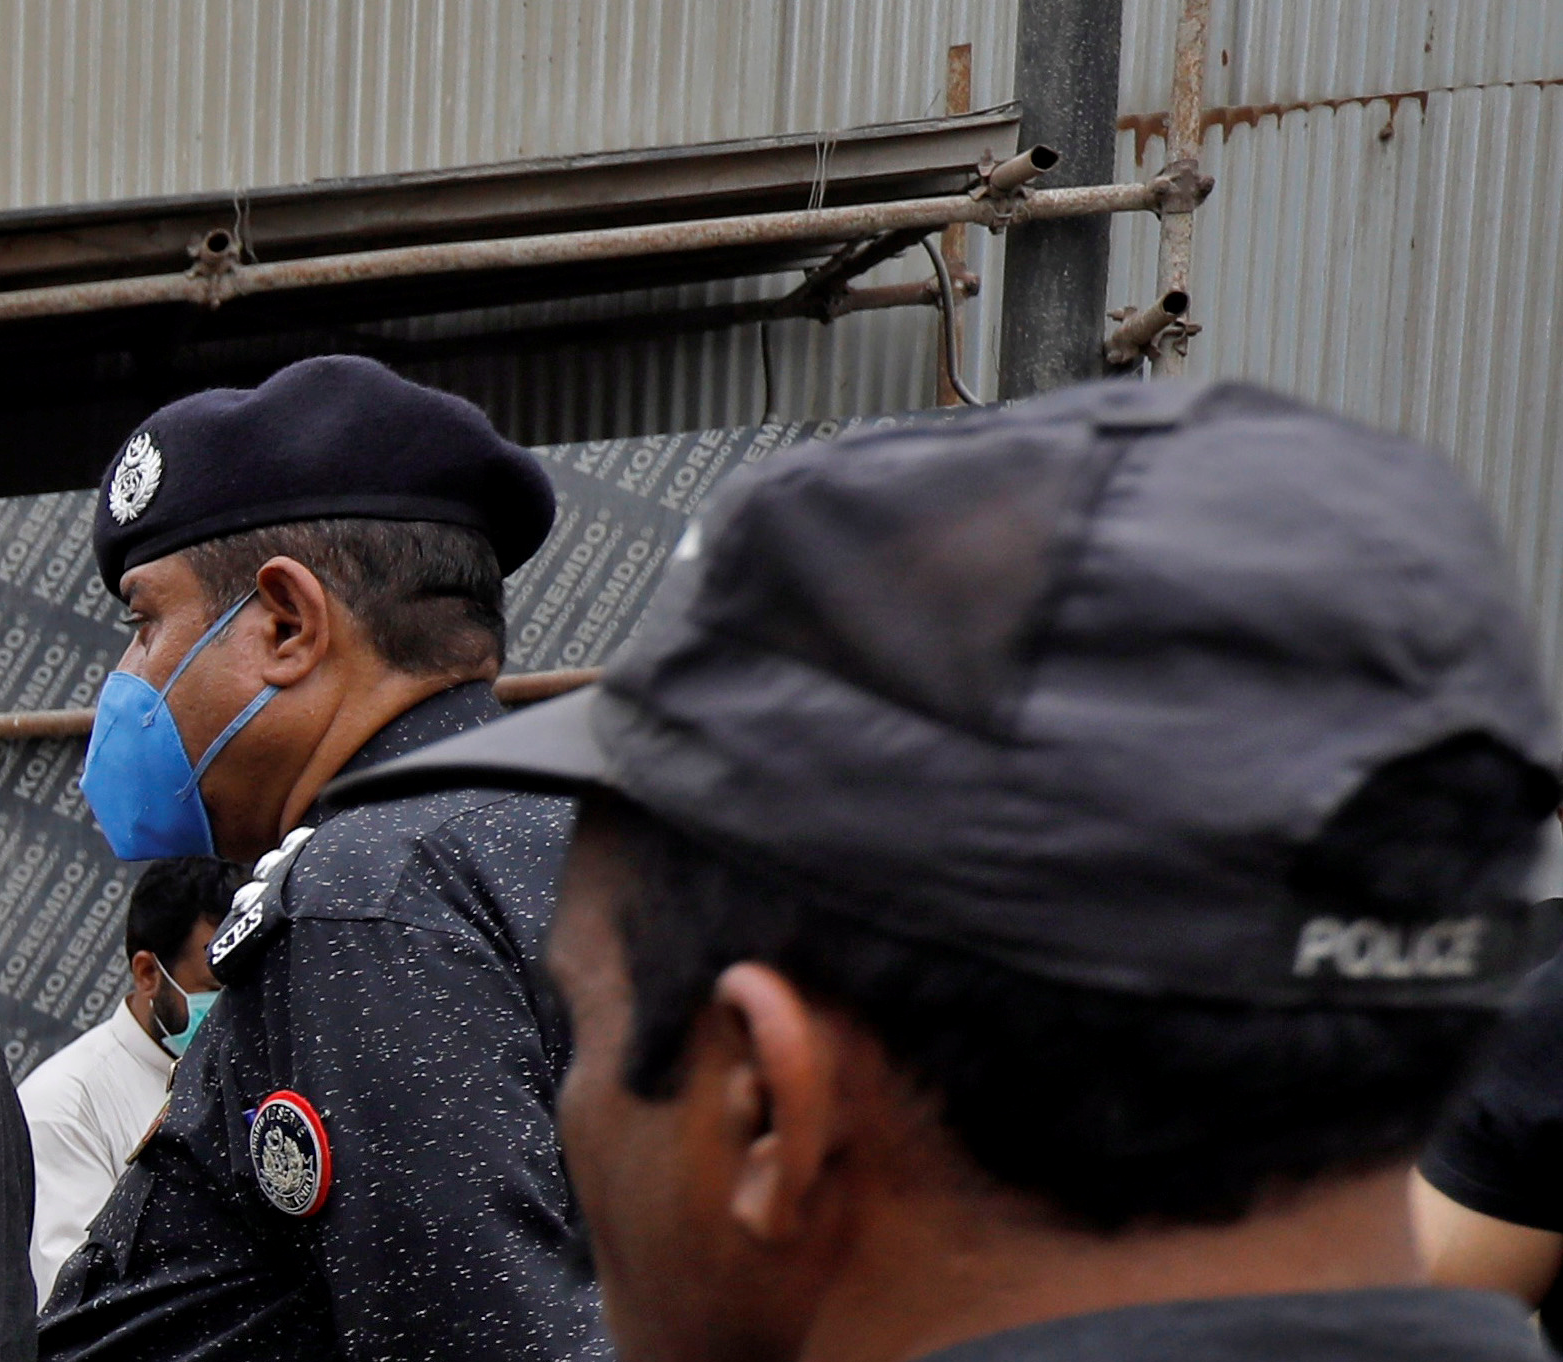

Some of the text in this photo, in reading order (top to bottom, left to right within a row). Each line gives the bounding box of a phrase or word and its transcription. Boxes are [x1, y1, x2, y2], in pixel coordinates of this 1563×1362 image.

[661, 424, 724, 510] KORE
[31, 497, 106, 600] KORE
[506, 512, 613, 666] KOREMDO
[557, 534, 653, 671] OREMDO
[10, 659, 111, 800] KODO
[31, 877, 127, 1013] KOREMDO
[72, 944, 134, 1030] KORE
[1293, 914, 1481, 979] POLICE
